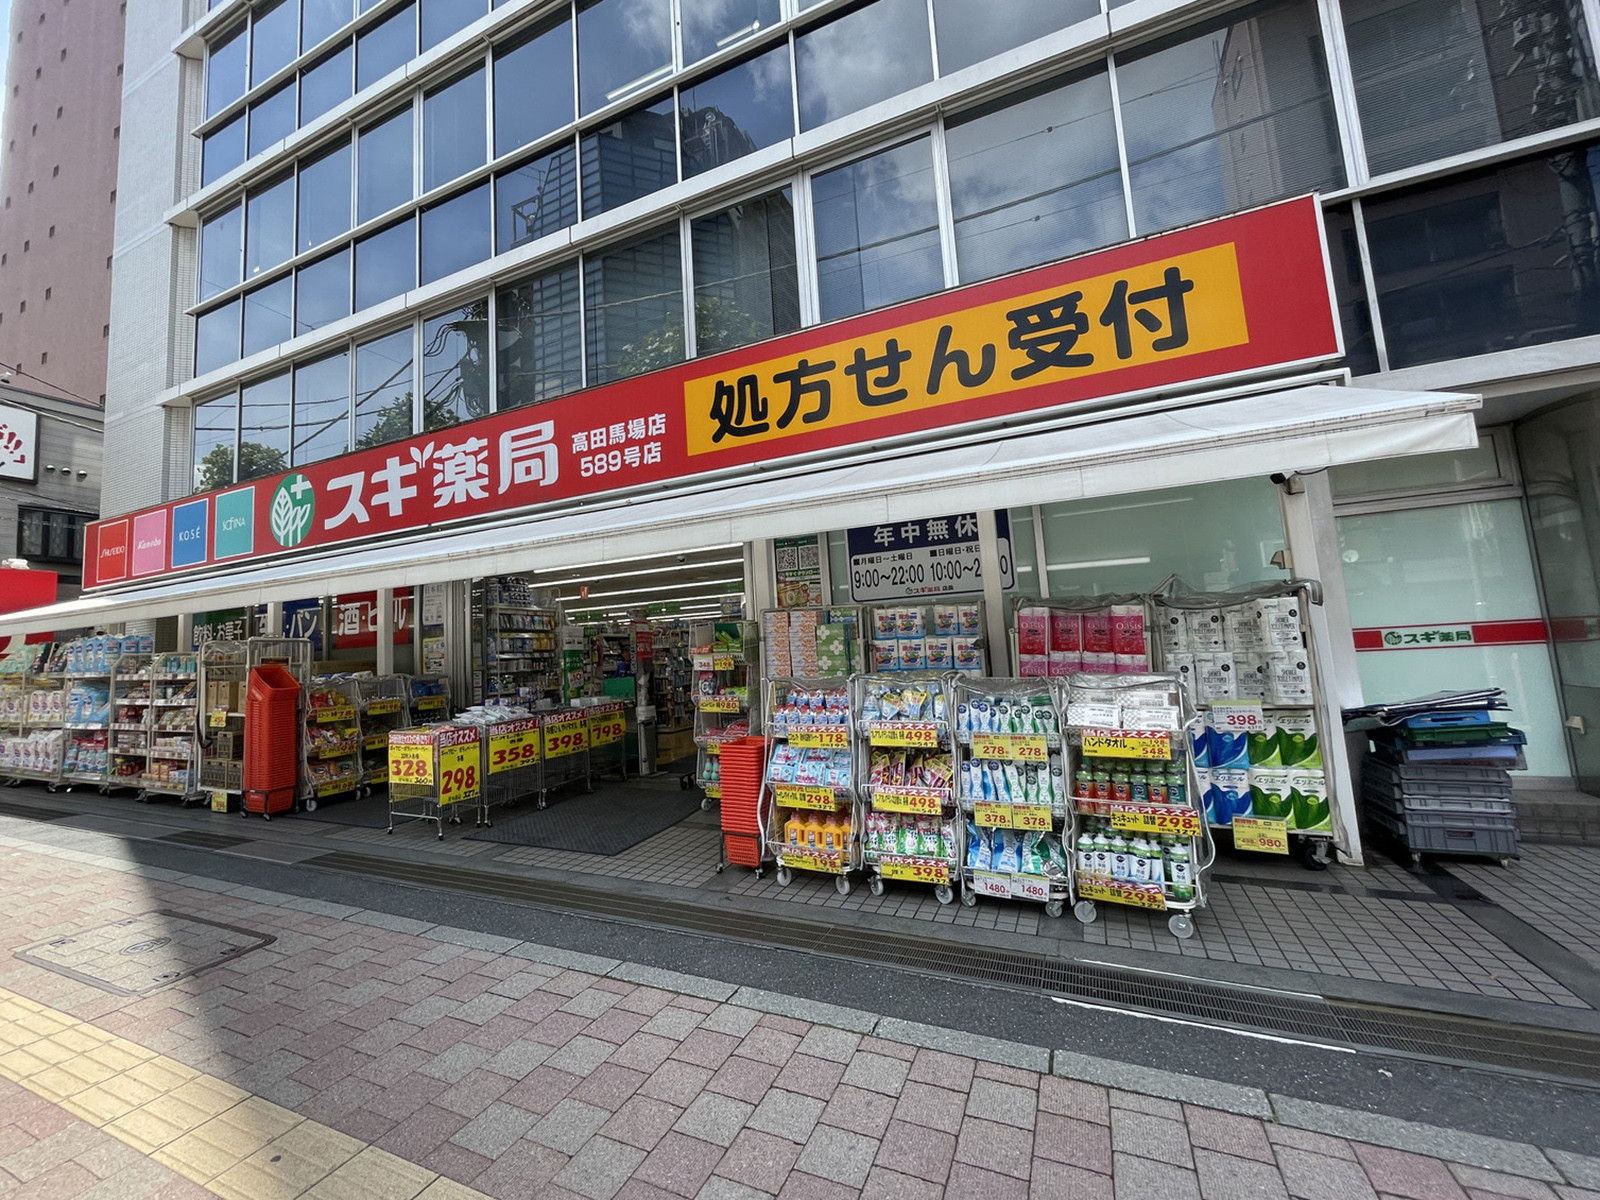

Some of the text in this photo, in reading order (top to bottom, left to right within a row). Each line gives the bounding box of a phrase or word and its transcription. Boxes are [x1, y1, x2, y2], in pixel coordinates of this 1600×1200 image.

[708, 266, 1194, 443] 処方せん受付
[571, 413, 666, 455] 高田馬場店
[580, 442, 662, 478] 589号店
[324, 420, 559, 530] スギ薬局
[222, 516, 246, 532] SOFINA
[873, 514, 978, 547] 年中無休
[178, 526, 201, 543] KOSÉ
[137, 538, 162, 550] Kanebo
[930, 555, 1008, 582] 10:00〜20
[338, 598, 407, 636] 酒・ル
[1116, 621, 1142, 631] Oasis
[1404, 630, 1472, 645] スギ薬局
[1082, 729, 1167, 739] 当店オススメ
[1084, 737, 1127, 748] ハンドタオル
[1256, 777, 1288, 785] エリエール
[1295, 778, 1325, 786] エリエール
[1110, 804, 1197, 817] 当店オススメ
[1111, 812, 1139, 824] キュキュット
[1079, 885, 1106, 895] キュキュット
